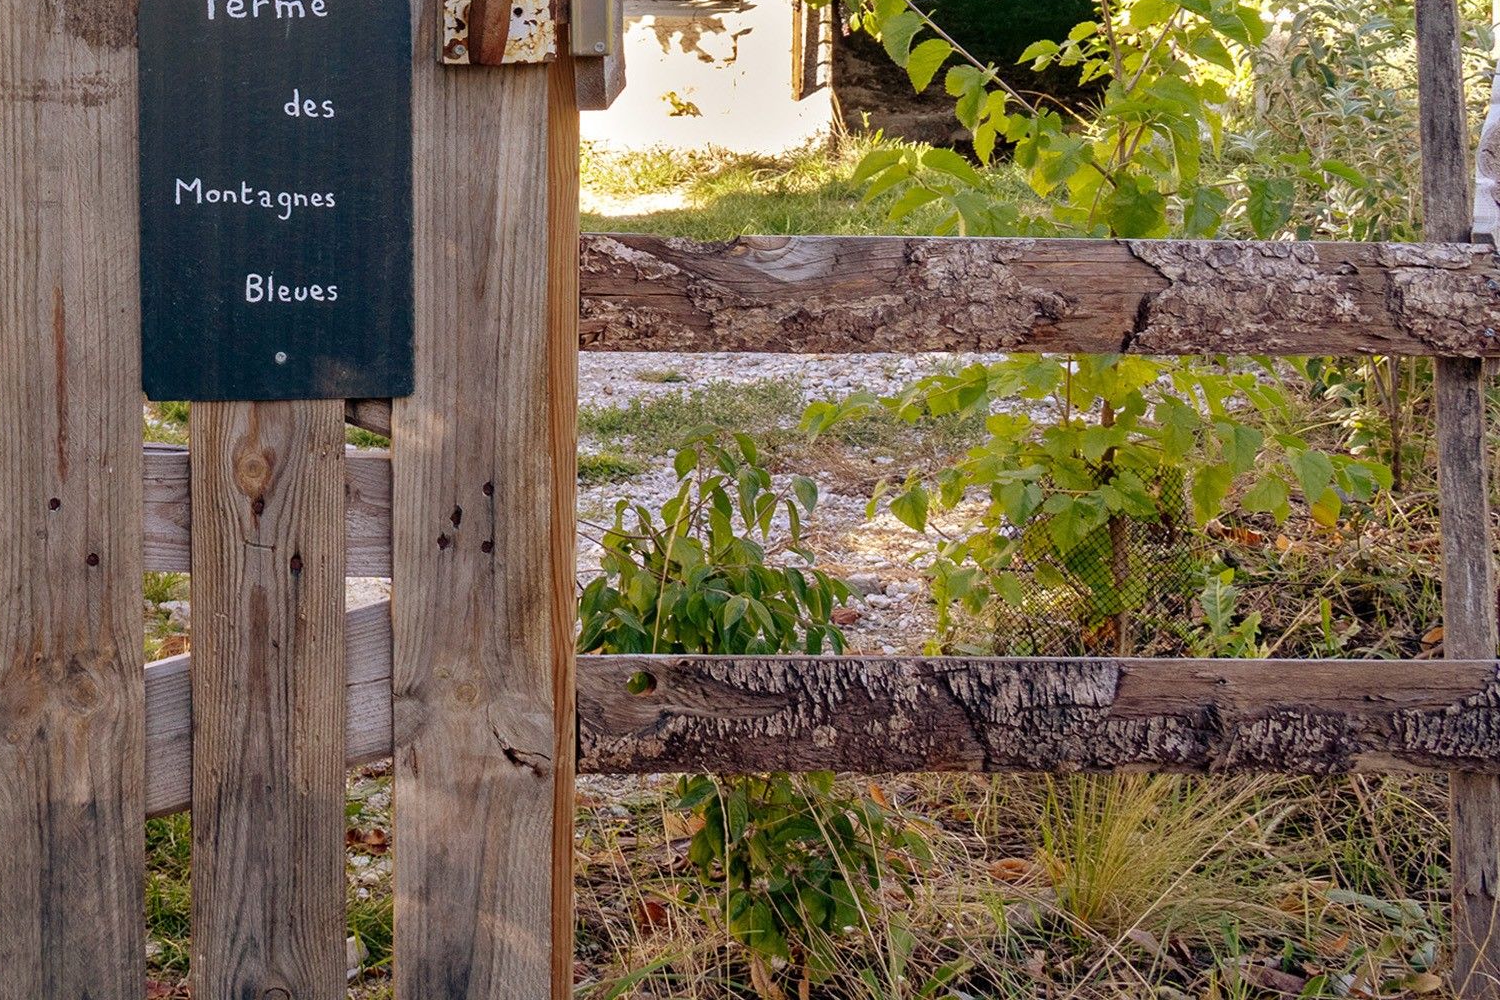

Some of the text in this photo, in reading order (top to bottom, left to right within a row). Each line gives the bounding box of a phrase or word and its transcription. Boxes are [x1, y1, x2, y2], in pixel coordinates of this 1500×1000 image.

[283, 88, 336, 119] des
[175, 177, 336, 220] Montagnes
[245, 273, 338, 303] Bleues
